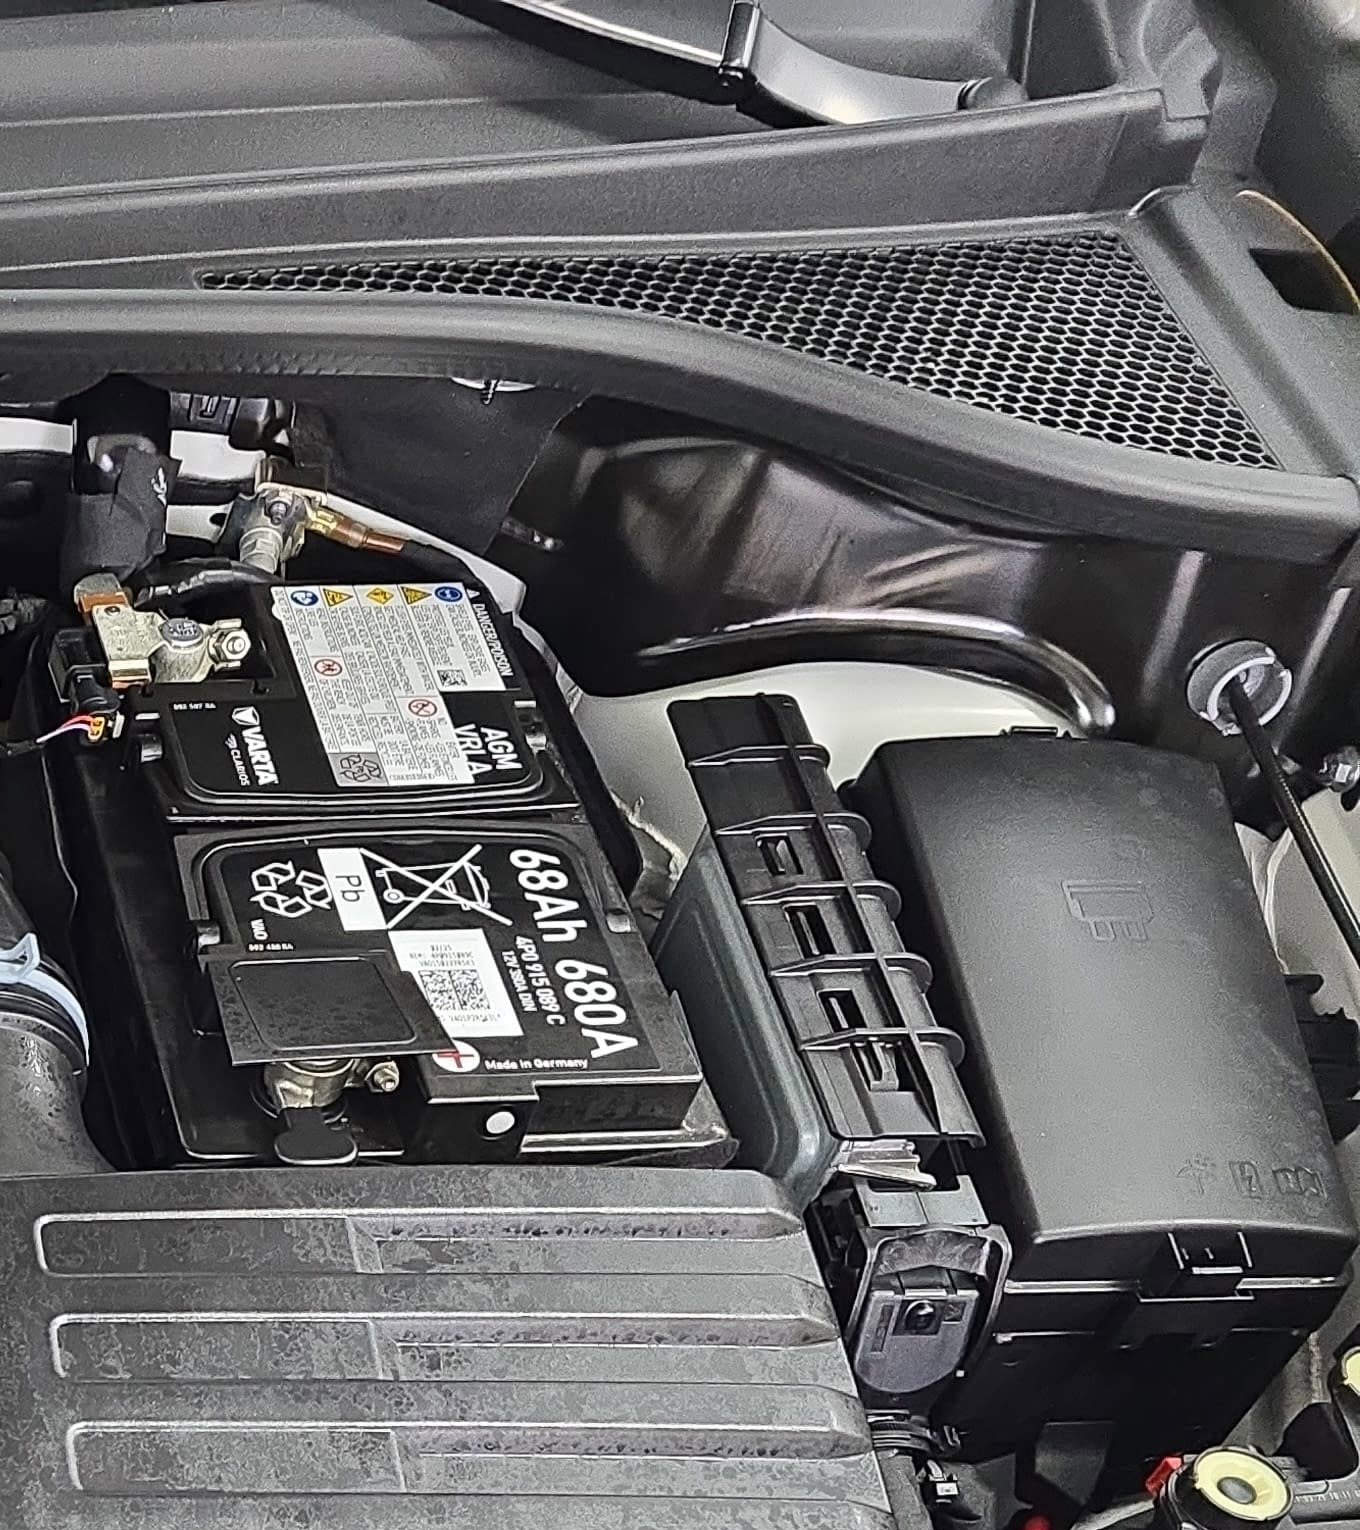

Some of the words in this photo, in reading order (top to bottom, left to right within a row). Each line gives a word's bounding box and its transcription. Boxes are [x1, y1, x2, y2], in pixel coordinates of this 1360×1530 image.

[472, 603, 514, 676] DANGER/POISON
[241, 726, 279, 786] VARTA
[480, 727, 523, 770] AGM
[230, 749, 250, 786] CLARIOS
[335, 875, 365, 902] Pb
[509, 849, 588, 943] 68Ah
[554, 958, 639, 1059] 680A
[502, 950, 519, 968] 12V
[519, 992, 538, 1013] DIN
[525, 962, 550, 988] 915
[535, 987, 561, 1013] 089
[546, 1014, 566, 1026] C
[484, 1059, 519, 1070] Made
[519, 1059, 533, 1069] in
[533, 1058, 589, 1069] Germany
